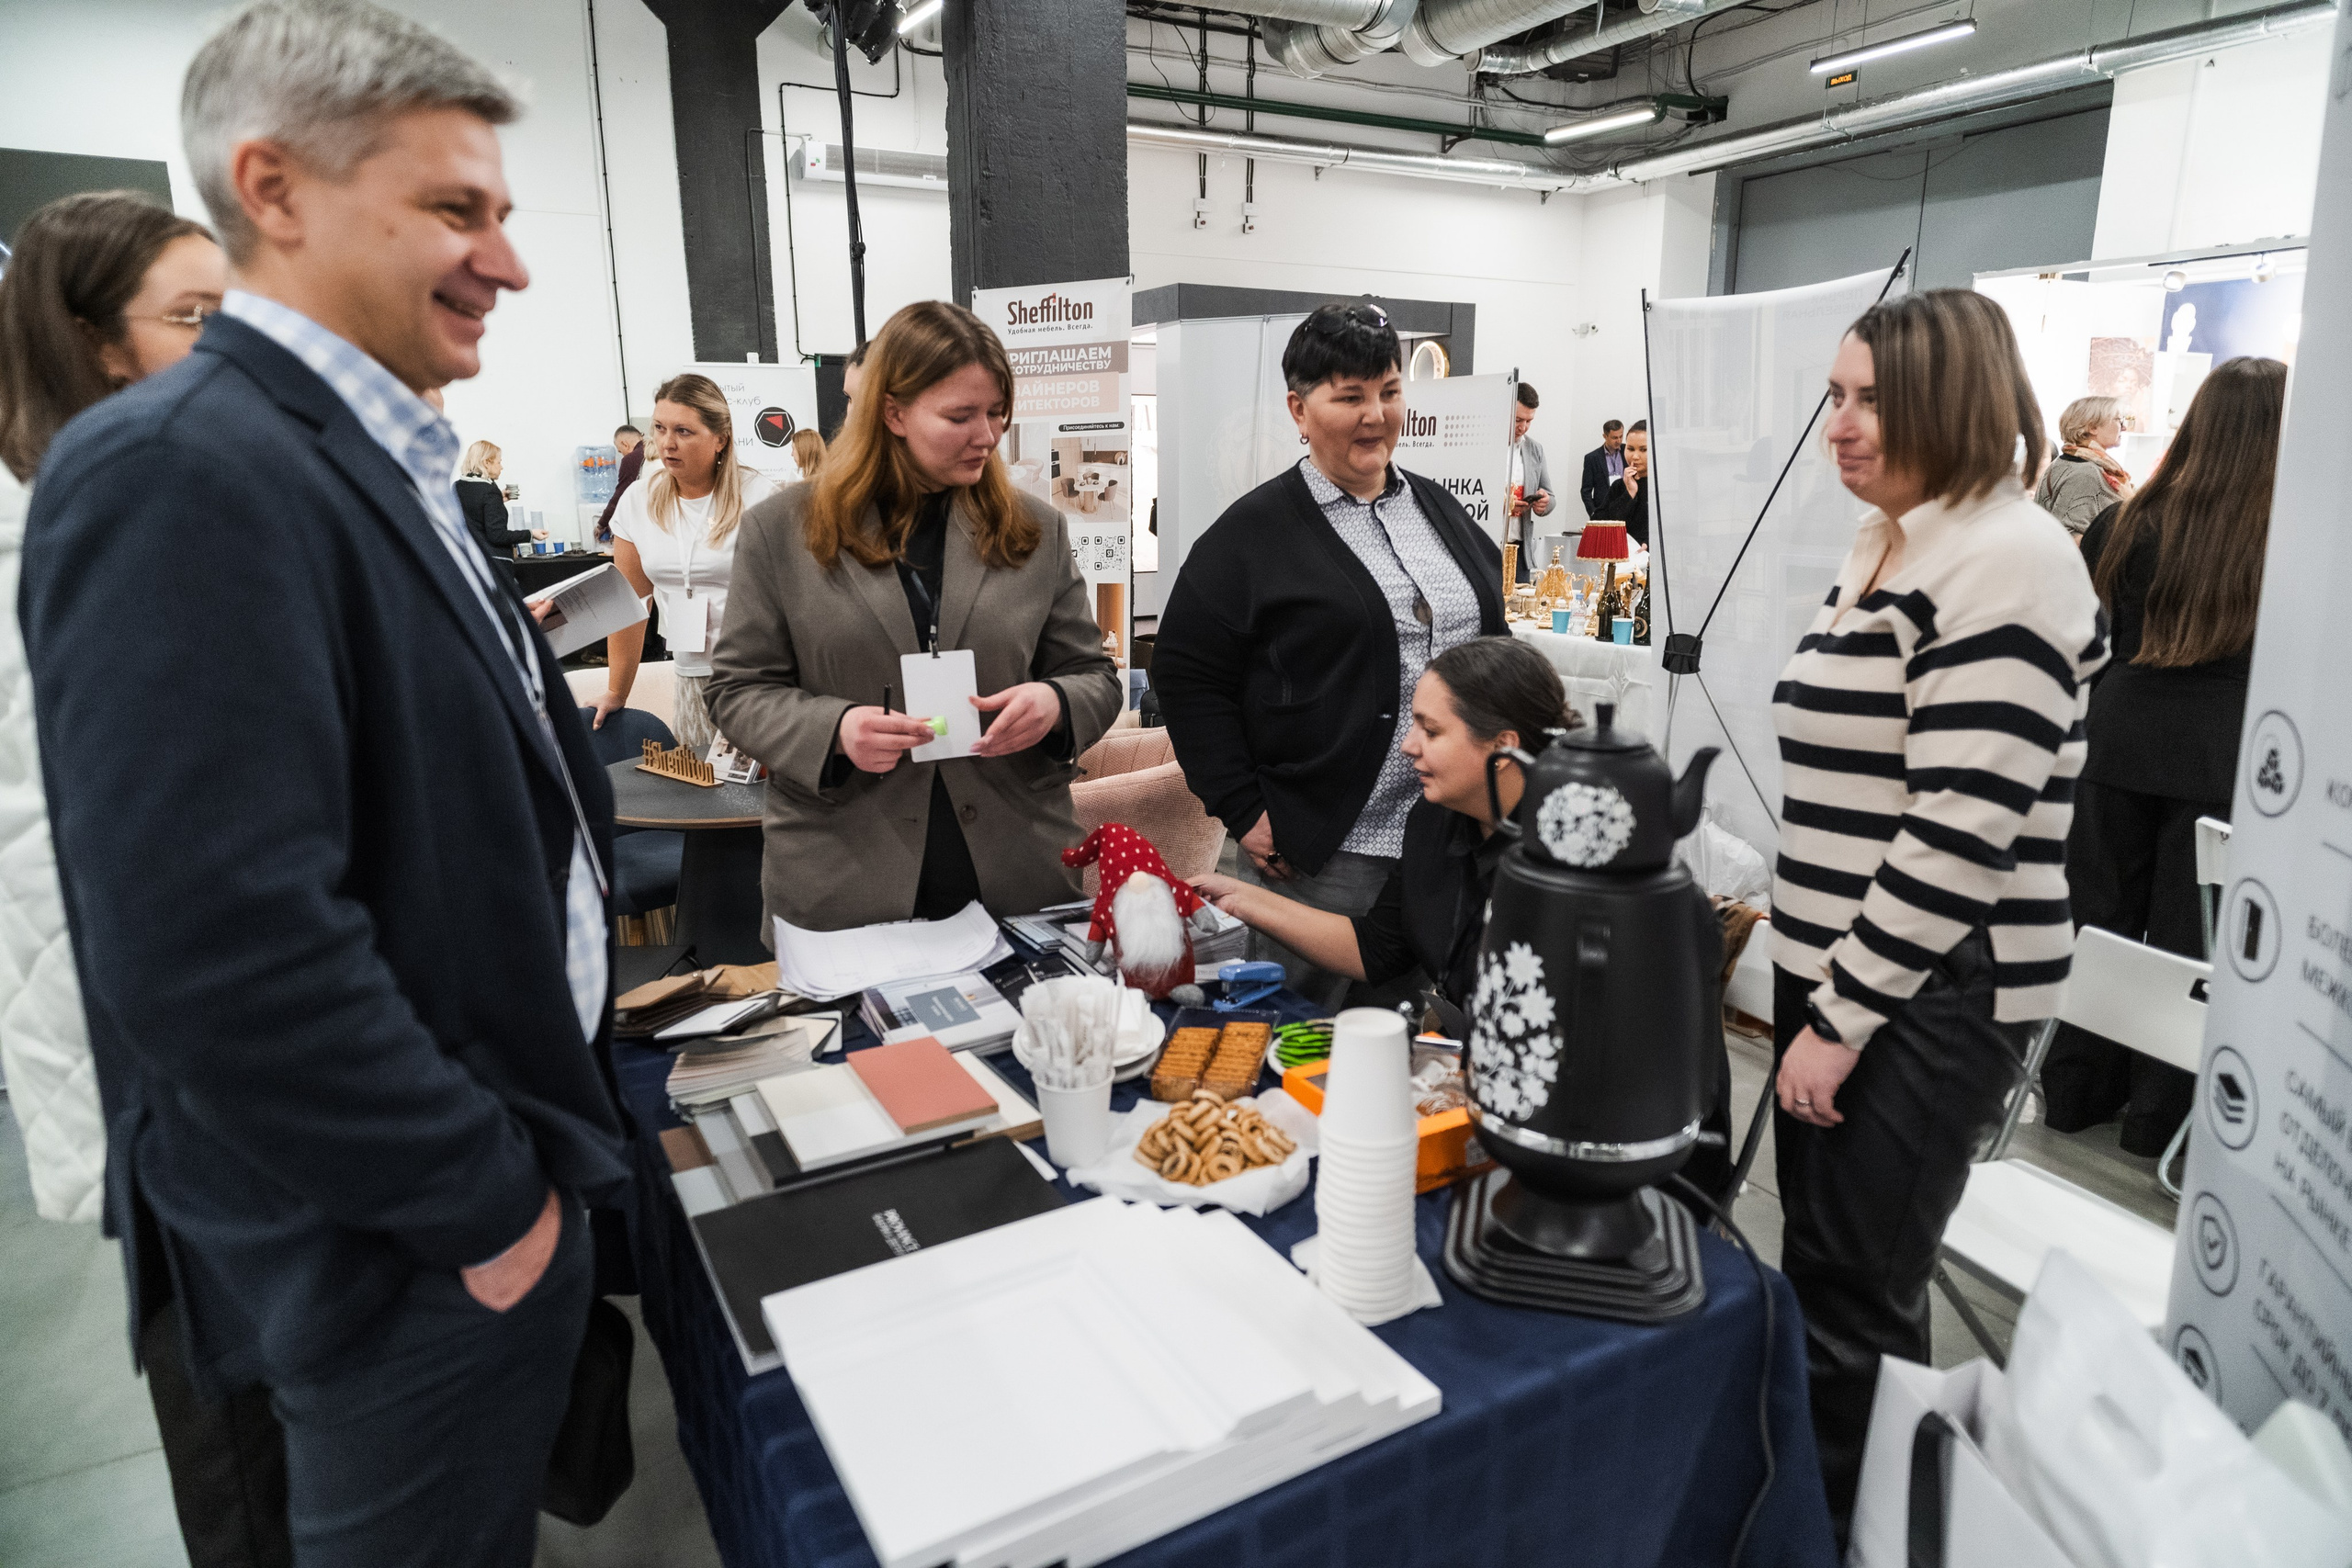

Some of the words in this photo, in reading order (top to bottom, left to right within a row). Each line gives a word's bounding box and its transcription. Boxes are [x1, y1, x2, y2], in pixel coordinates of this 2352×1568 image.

[1008, 292, 1093, 325] Sheffilton
[1008, 327, 1036, 335] Удобная
[1008, 346, 1112, 365] РИГЛАШАЕМ
[719, 382, 745, 392] ытый
[1013, 379, 1101, 398] ЗАЙНЕРОВ
[726, 396, 762, 407] с-клуб
[642, 739, 715, 784] #Sheffilton
